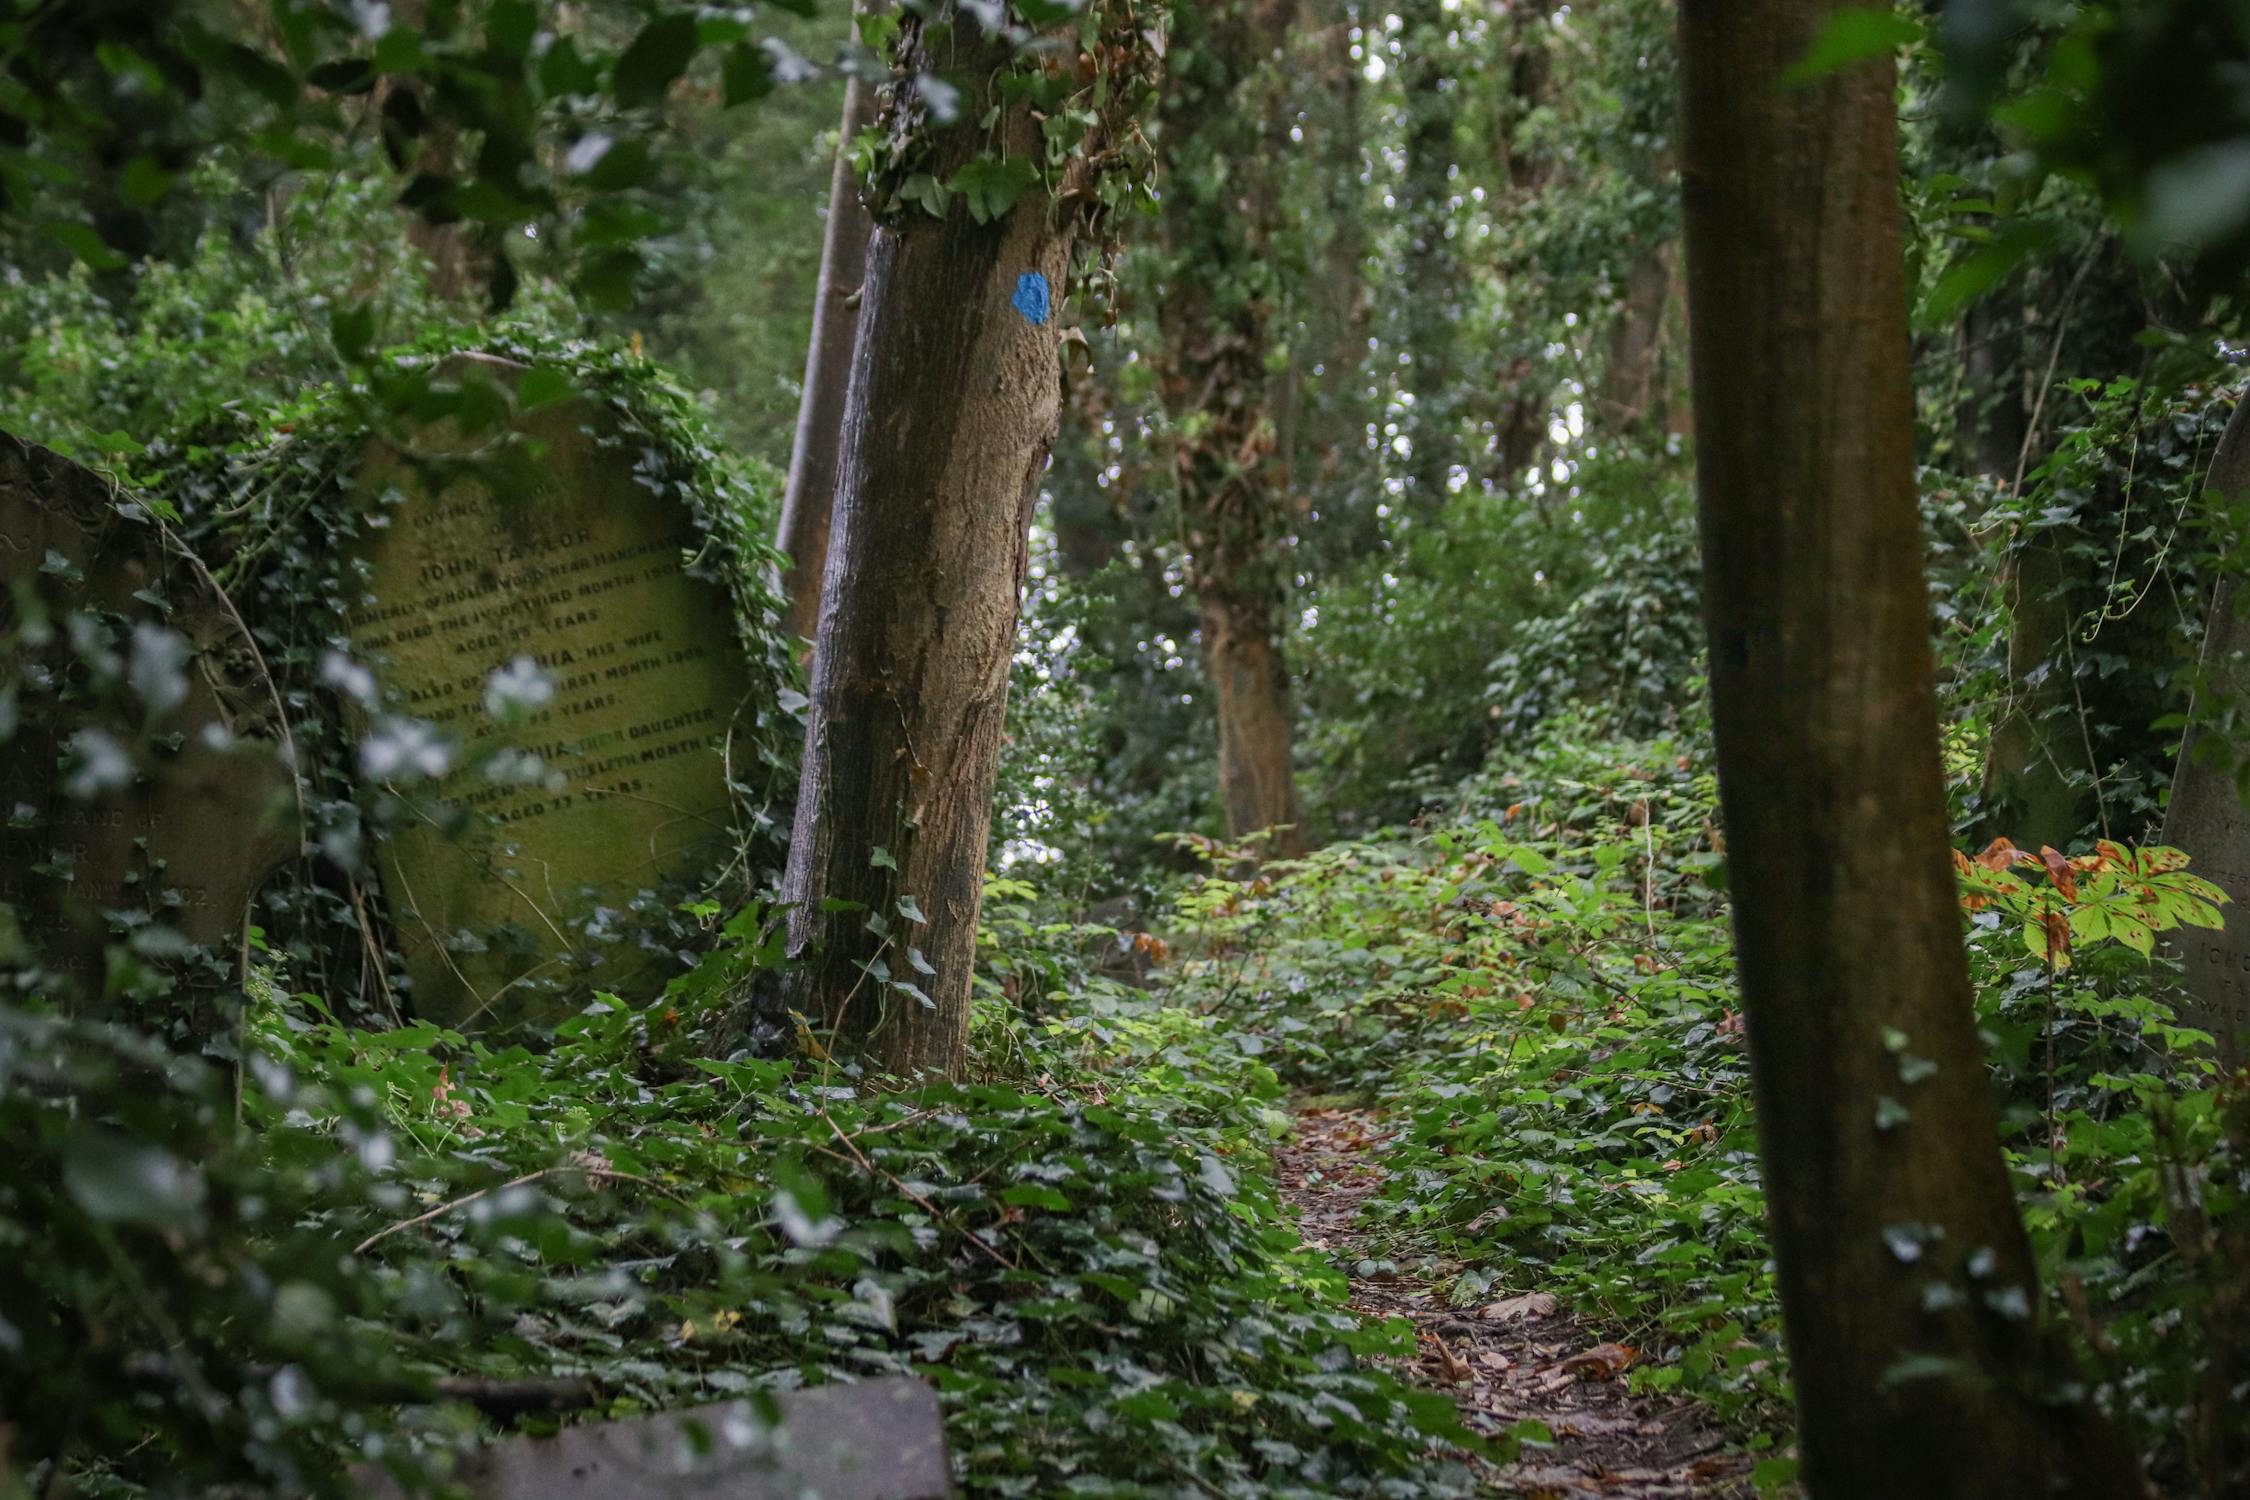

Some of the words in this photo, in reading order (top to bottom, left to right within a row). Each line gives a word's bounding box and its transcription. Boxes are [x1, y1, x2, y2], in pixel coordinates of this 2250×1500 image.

[417, 555, 479, 587] JOHN
[494, 528, 593, 564] TAYLOR
[424, 594, 441, 610] OF
[548, 556, 590, 579] NEAR
[395, 624, 433, 643] DIED
[439, 614, 469, 633] THE
[521, 588, 572, 614] THIRD
[577, 574, 636, 597] MONTH
[455, 634, 500, 656] AGED
[409, 681, 454, 704] ALSO
[460, 675, 480, 691] OF
[585, 641, 616, 659] HIS
[624, 629, 664, 649] WIFE
[556, 671, 598, 693] IRST
[604, 657, 661, 680] MONTH
[628, 706, 714, 741] DAUGHTER
[639, 737, 702, 763] MONTH
[499, 802, 545, 824] AGED
